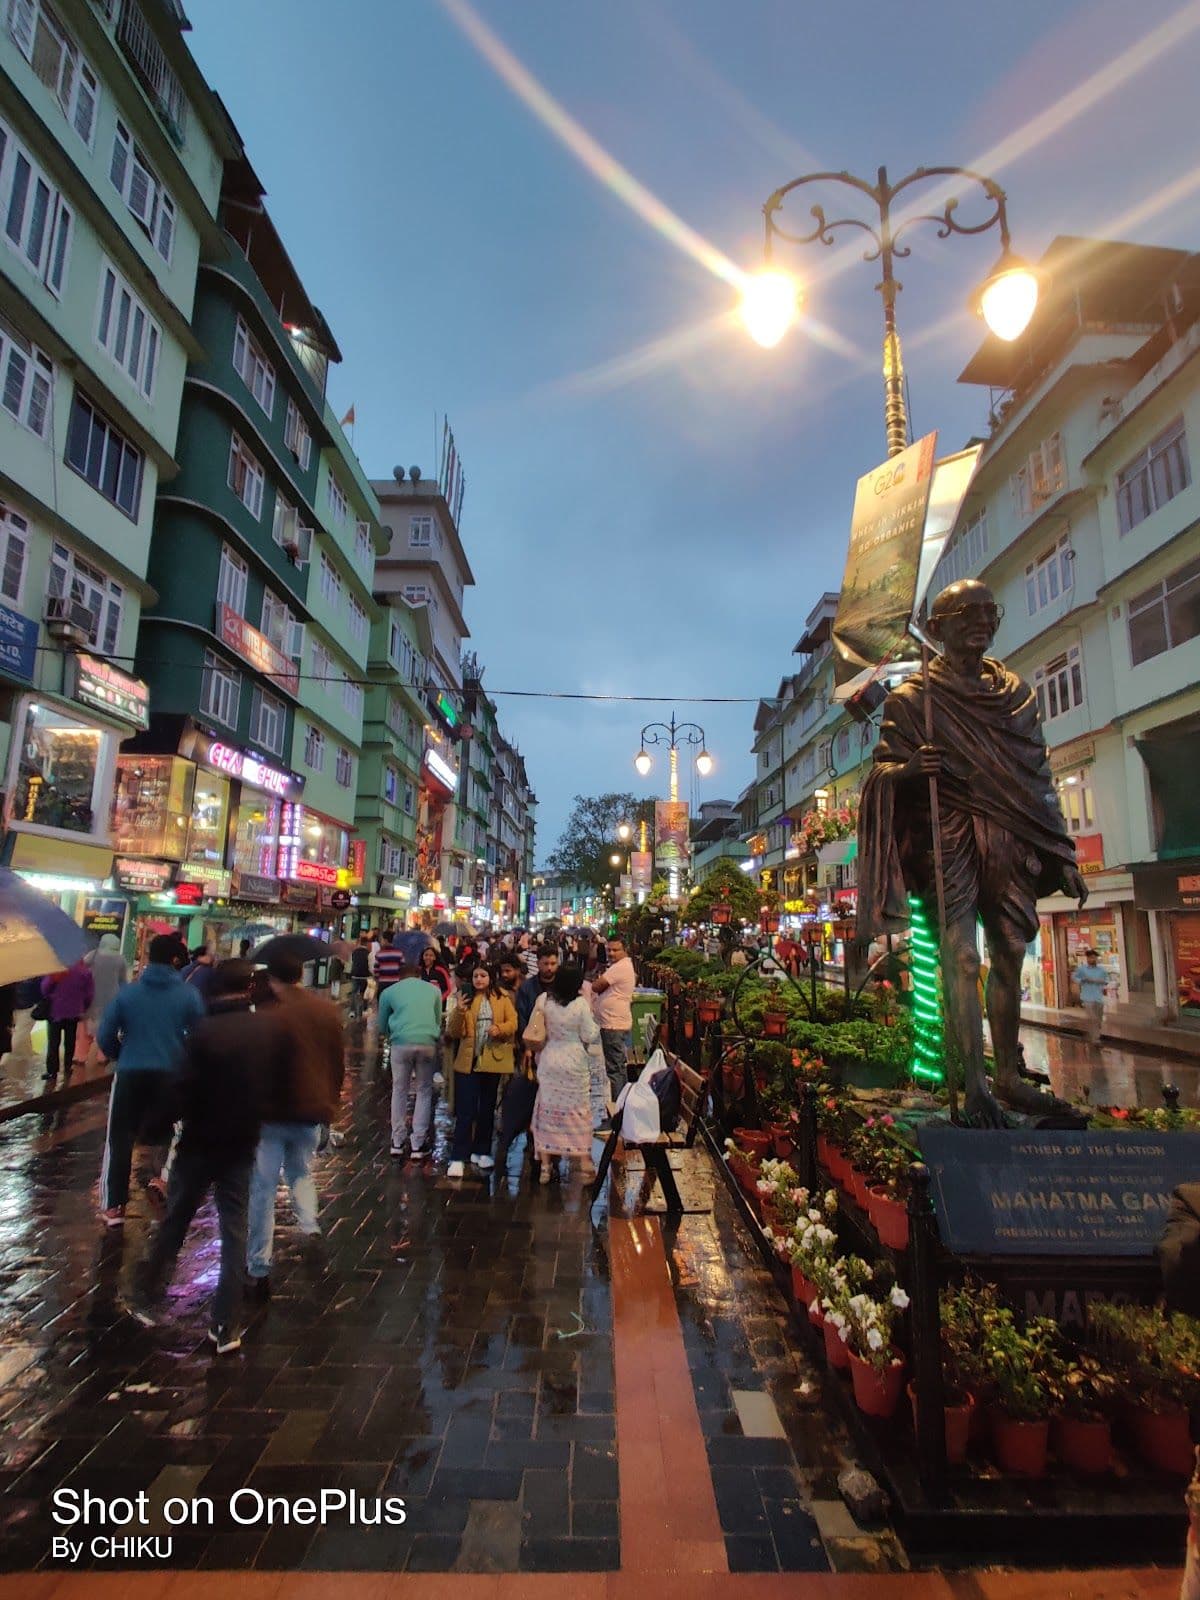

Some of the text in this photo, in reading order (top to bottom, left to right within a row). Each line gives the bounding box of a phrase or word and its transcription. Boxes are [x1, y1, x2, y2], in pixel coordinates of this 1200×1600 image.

[892, 495, 927, 519] SIKKIM
[873, 518, 916, 543] ORGANIC
[1085, 863, 1100, 872] Sons
[1012, 1143, 1166, 1156] FATHER OF THE NATION
[991, 1191, 1118, 1210] MAHATMA
